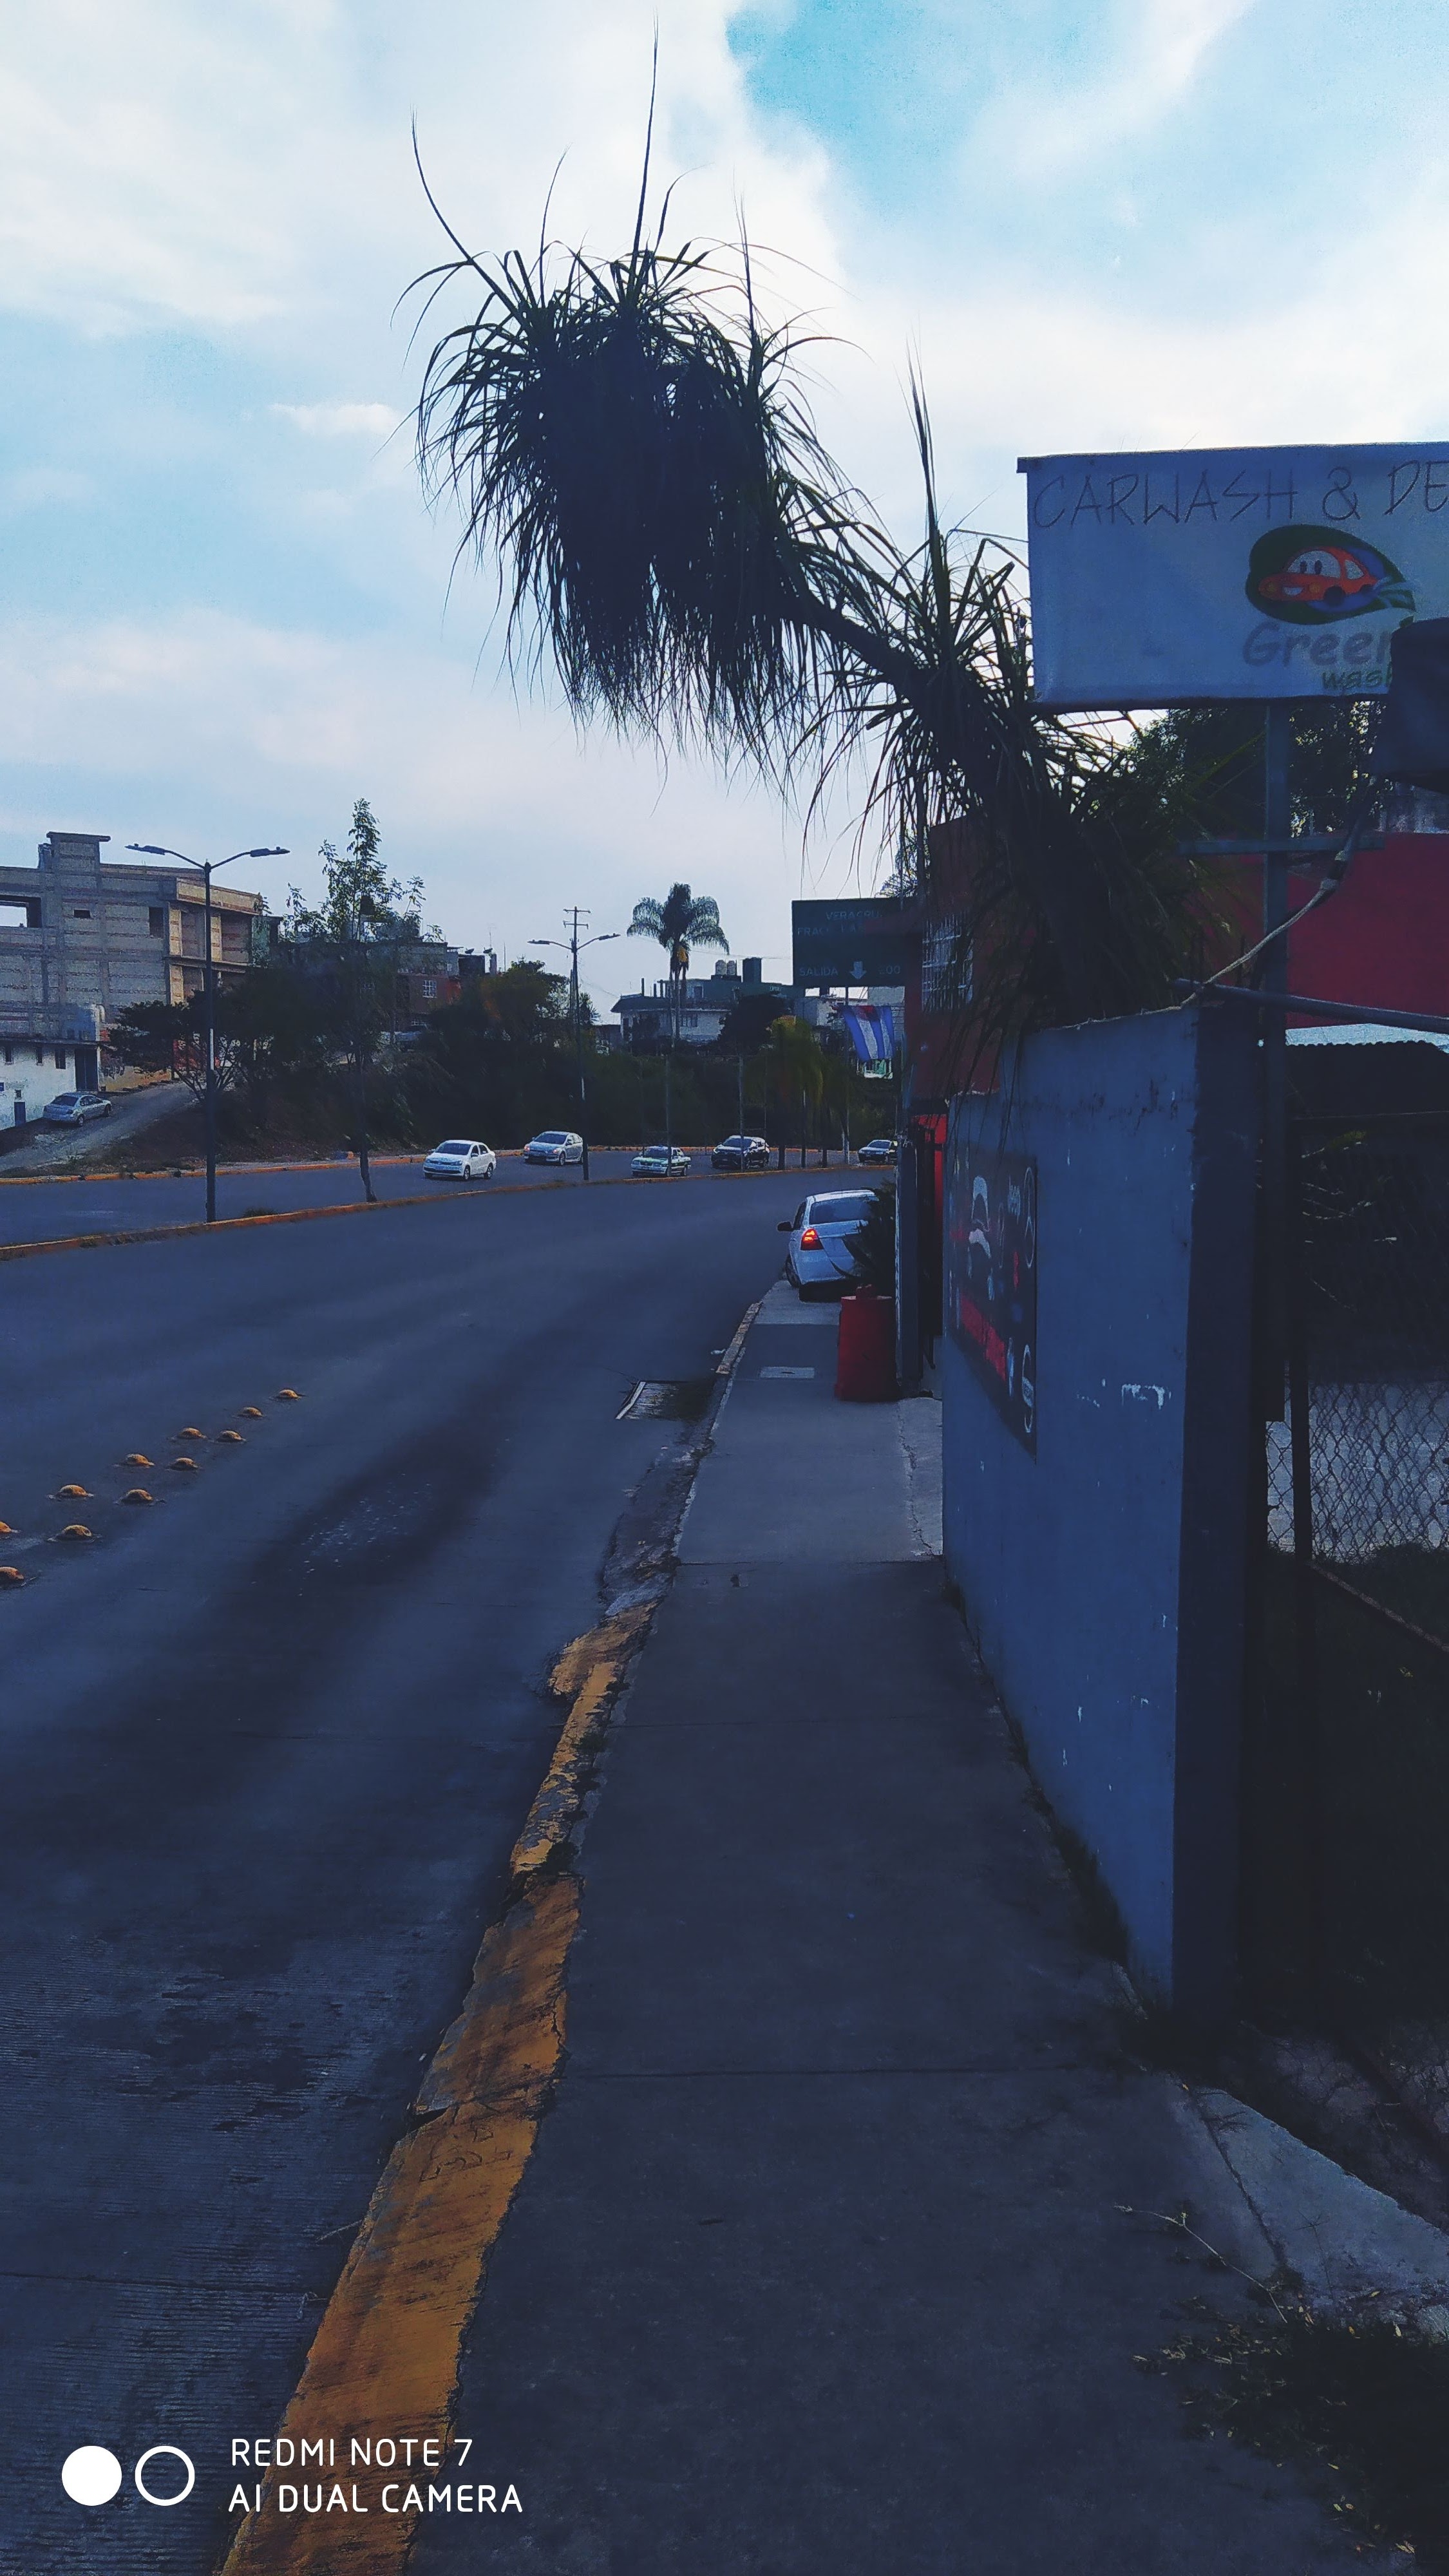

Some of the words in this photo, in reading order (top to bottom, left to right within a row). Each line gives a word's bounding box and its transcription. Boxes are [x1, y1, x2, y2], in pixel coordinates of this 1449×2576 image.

[1034, 468, 1298, 529] CARWASH
[1322, 466, 1361, 520] &
[826, 910, 883, 921] VERACRU
[799, 964, 838, 976] SALIDA
